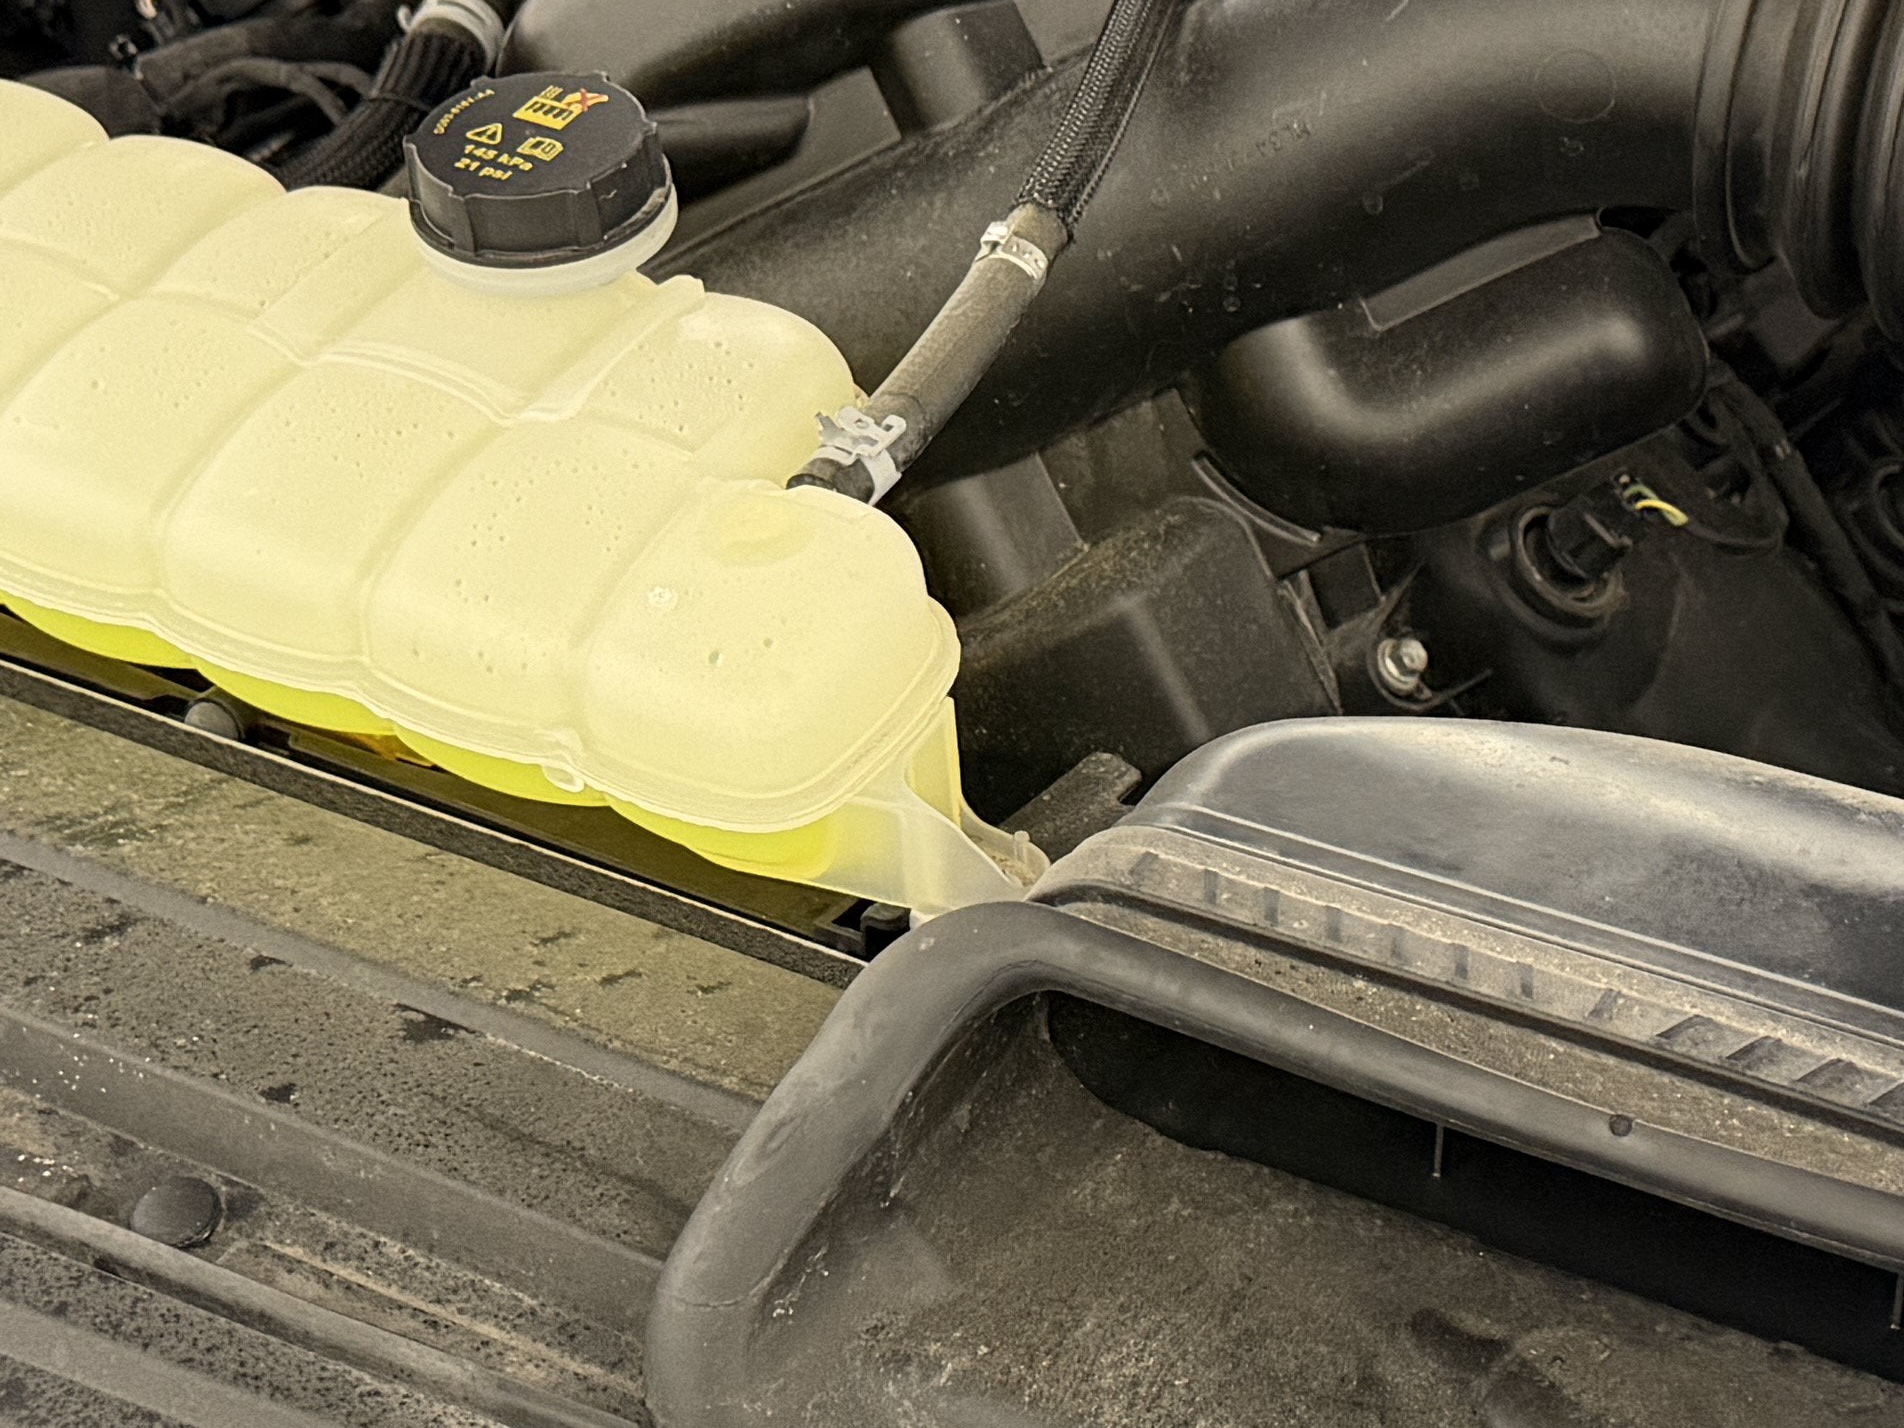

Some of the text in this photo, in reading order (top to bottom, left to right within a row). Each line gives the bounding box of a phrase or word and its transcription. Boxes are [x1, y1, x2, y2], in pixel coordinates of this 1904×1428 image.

[464, 144, 498, 160] 145
[454, 158, 513, 180] 21 psi
